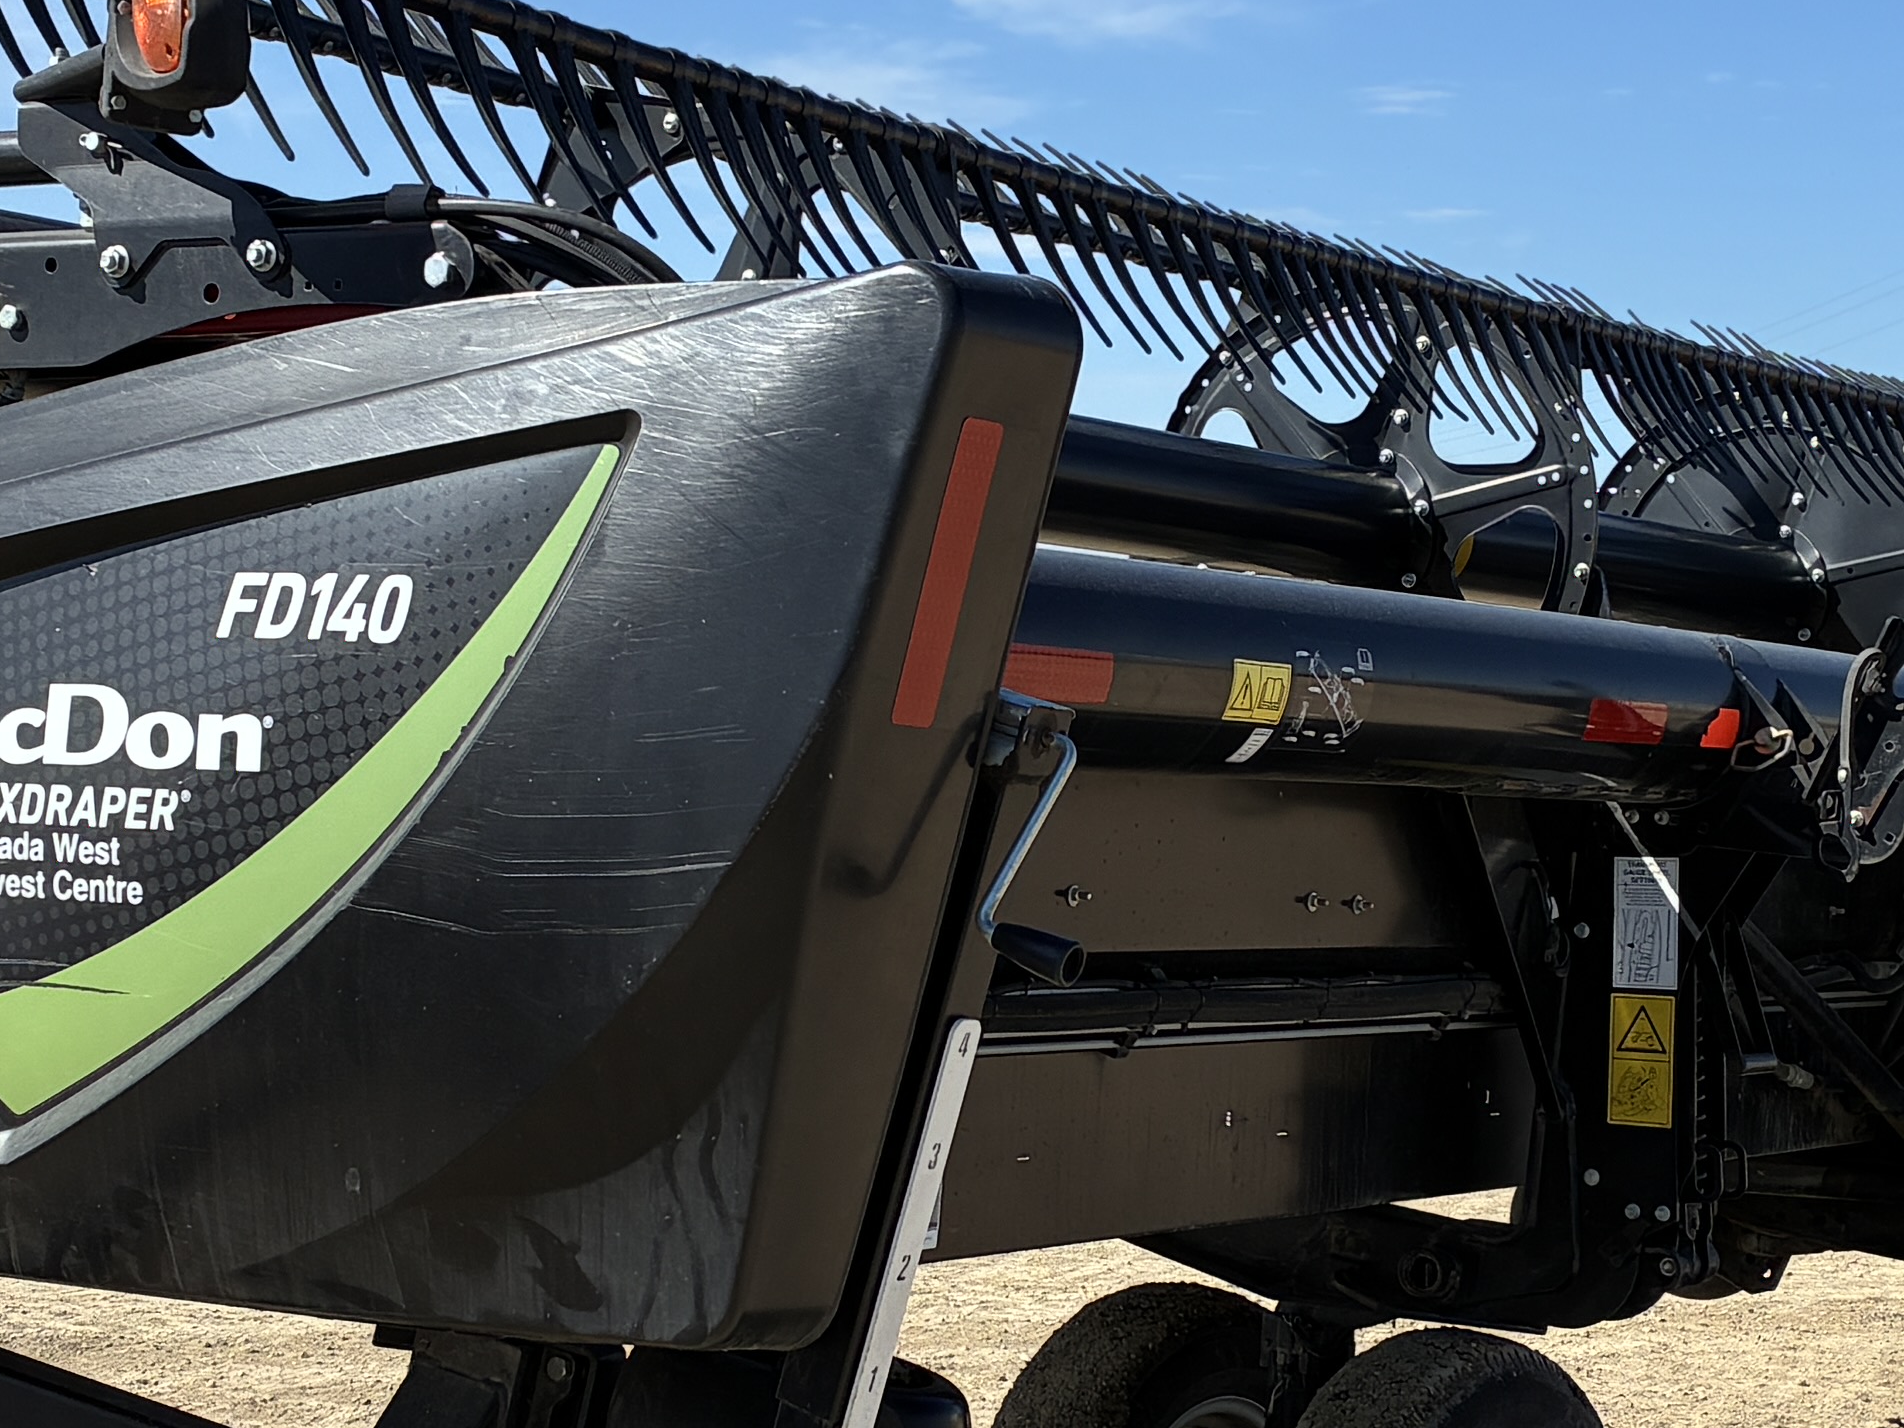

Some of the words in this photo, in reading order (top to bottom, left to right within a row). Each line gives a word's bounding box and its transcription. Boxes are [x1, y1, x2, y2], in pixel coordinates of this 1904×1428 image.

[216, 571, 414, 644] FD140
[54, 833, 121, 866] West
[53, 870, 144, 905] Centre
[958, 1032, 971, 1058] 4
[927, 1143, 941, 1170] 3
[896, 1255, 911, 1281] 2
[868, 1365, 879, 1393] 1
